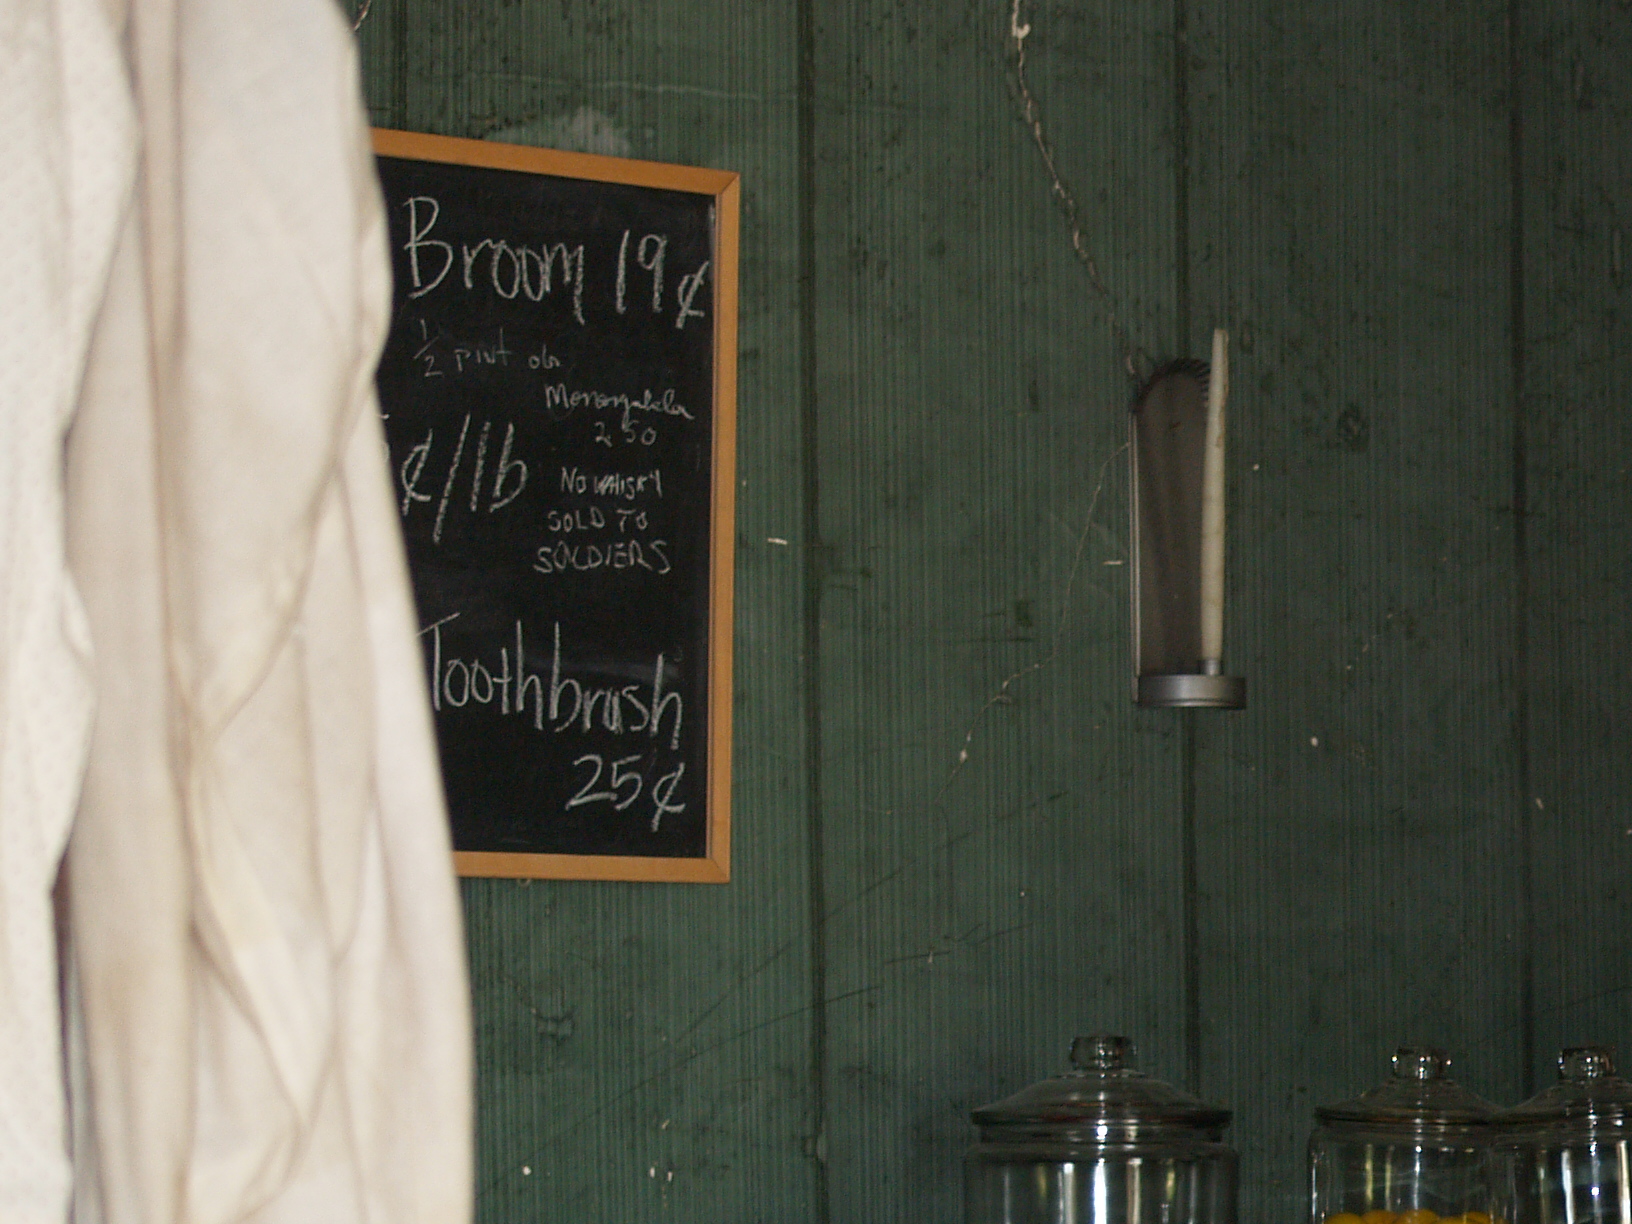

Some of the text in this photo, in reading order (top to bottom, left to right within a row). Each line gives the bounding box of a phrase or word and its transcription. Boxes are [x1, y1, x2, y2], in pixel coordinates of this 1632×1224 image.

[547, 505, 606, 533] SOLD
[532, 539, 671, 574] SOLDIERS
[416, 611, 684, 750] Toothbrush
